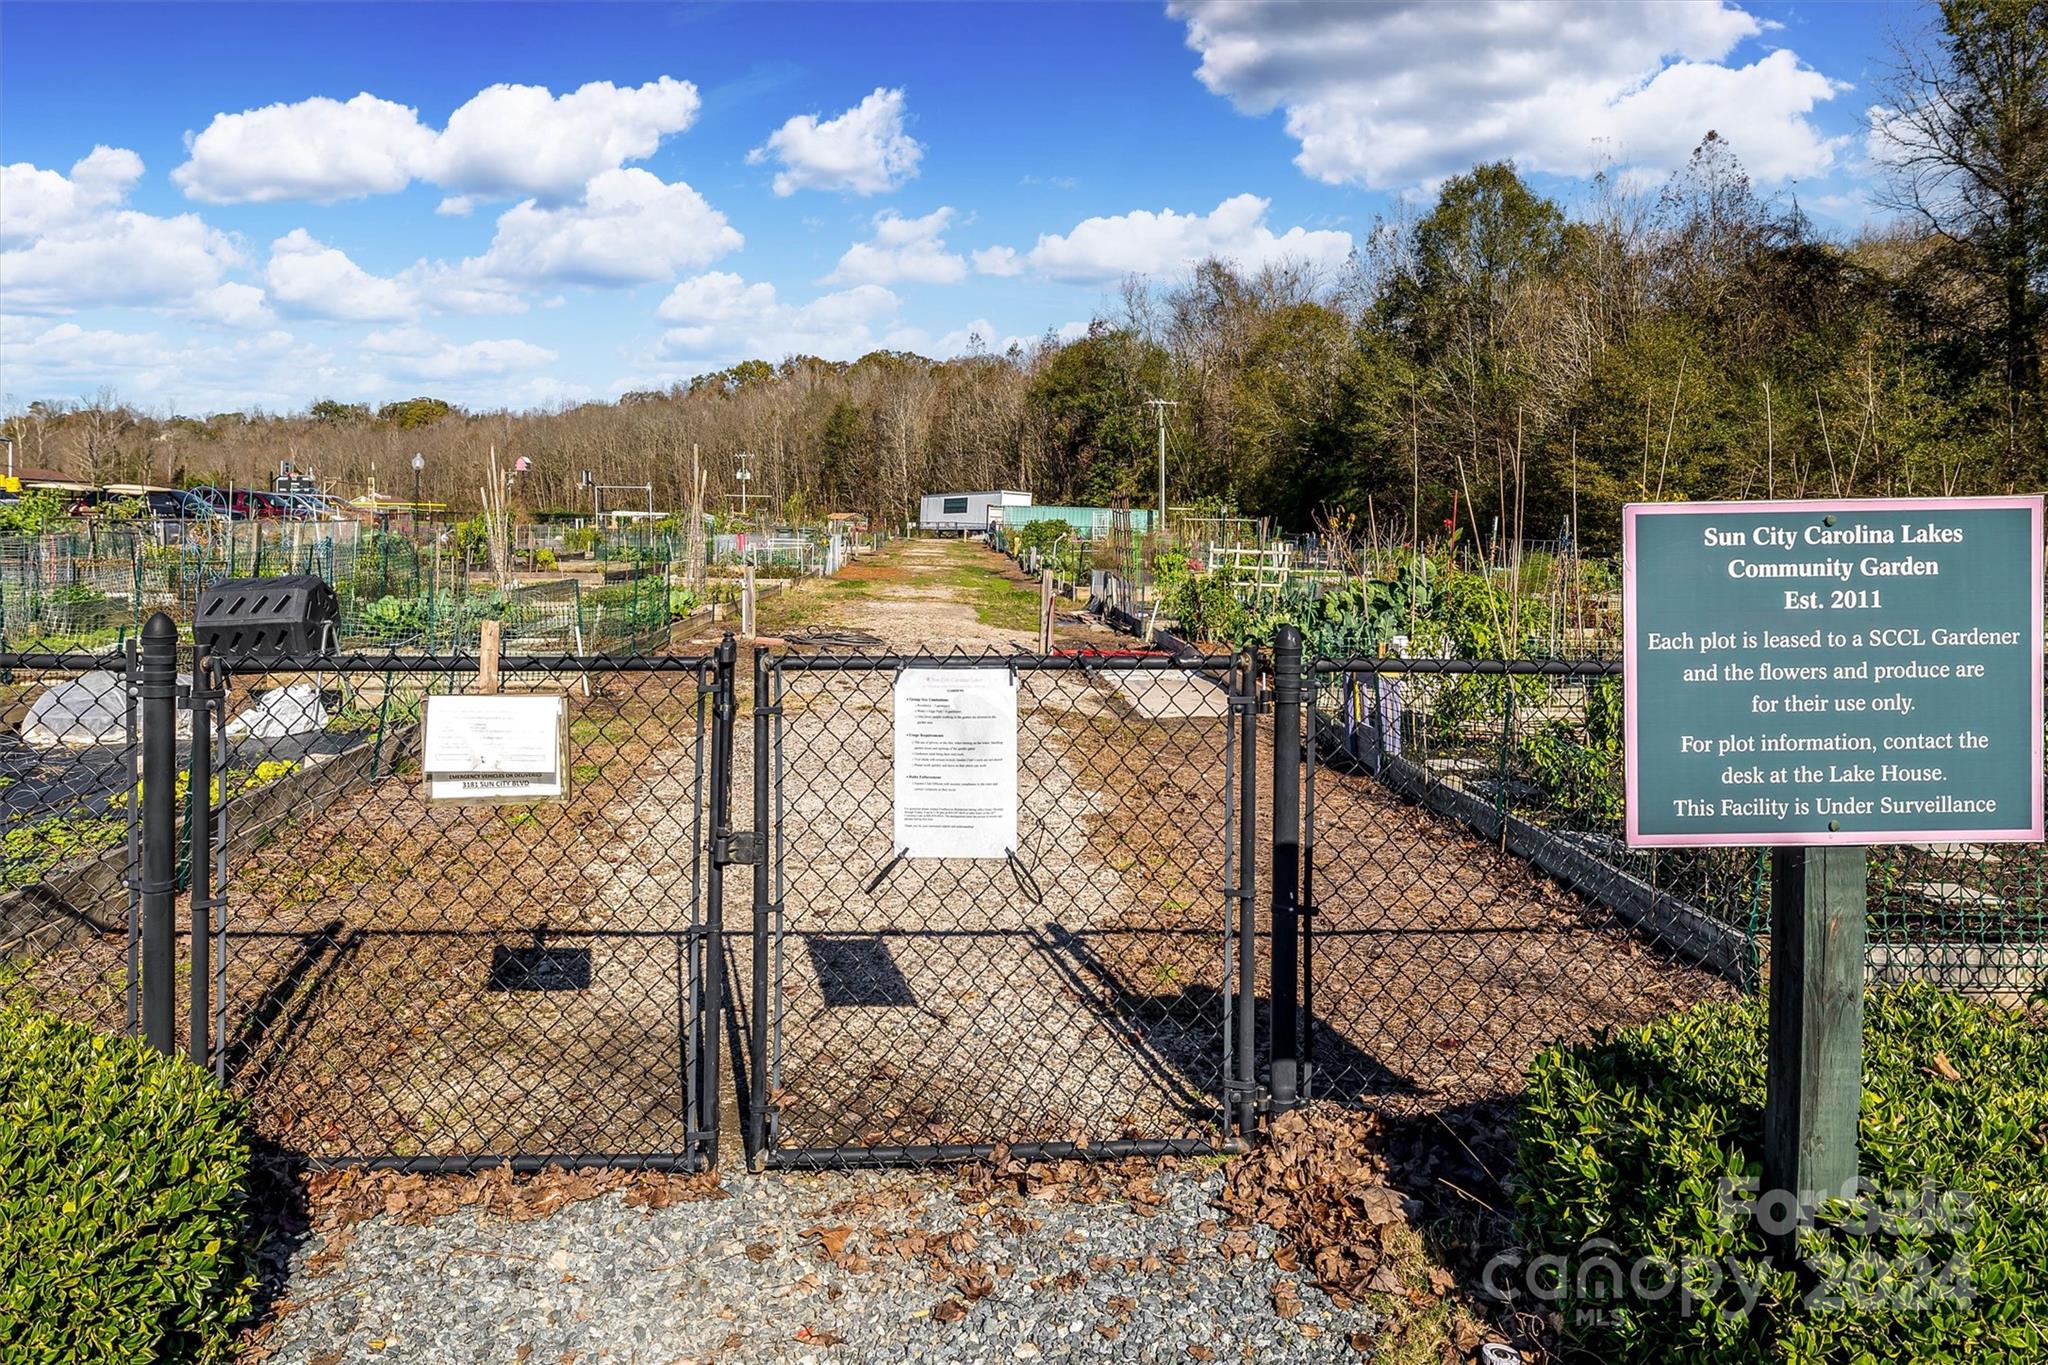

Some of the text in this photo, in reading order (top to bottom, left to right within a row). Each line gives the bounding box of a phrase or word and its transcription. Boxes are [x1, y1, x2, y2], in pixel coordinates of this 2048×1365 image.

[1704, 523, 1963, 550] Sun City Carolina Lakes
[1728, 556, 1939, 581] Community Garden
[1784, 590, 1882, 609] Est. 2011
[1648, 628, 2020, 653] Each plot is leased to a SCCL Gardener
[1683, 661, 1984, 683] and the flowers and produce are
[1752, 693, 1915, 715] for their use only.
[1681, 731, 1988, 756] For plot information, contact the
[1722, 765, 1946, 784] desk at the Lake House.
[1673, 795, 1996, 819] This Facility is Under Surveillance
